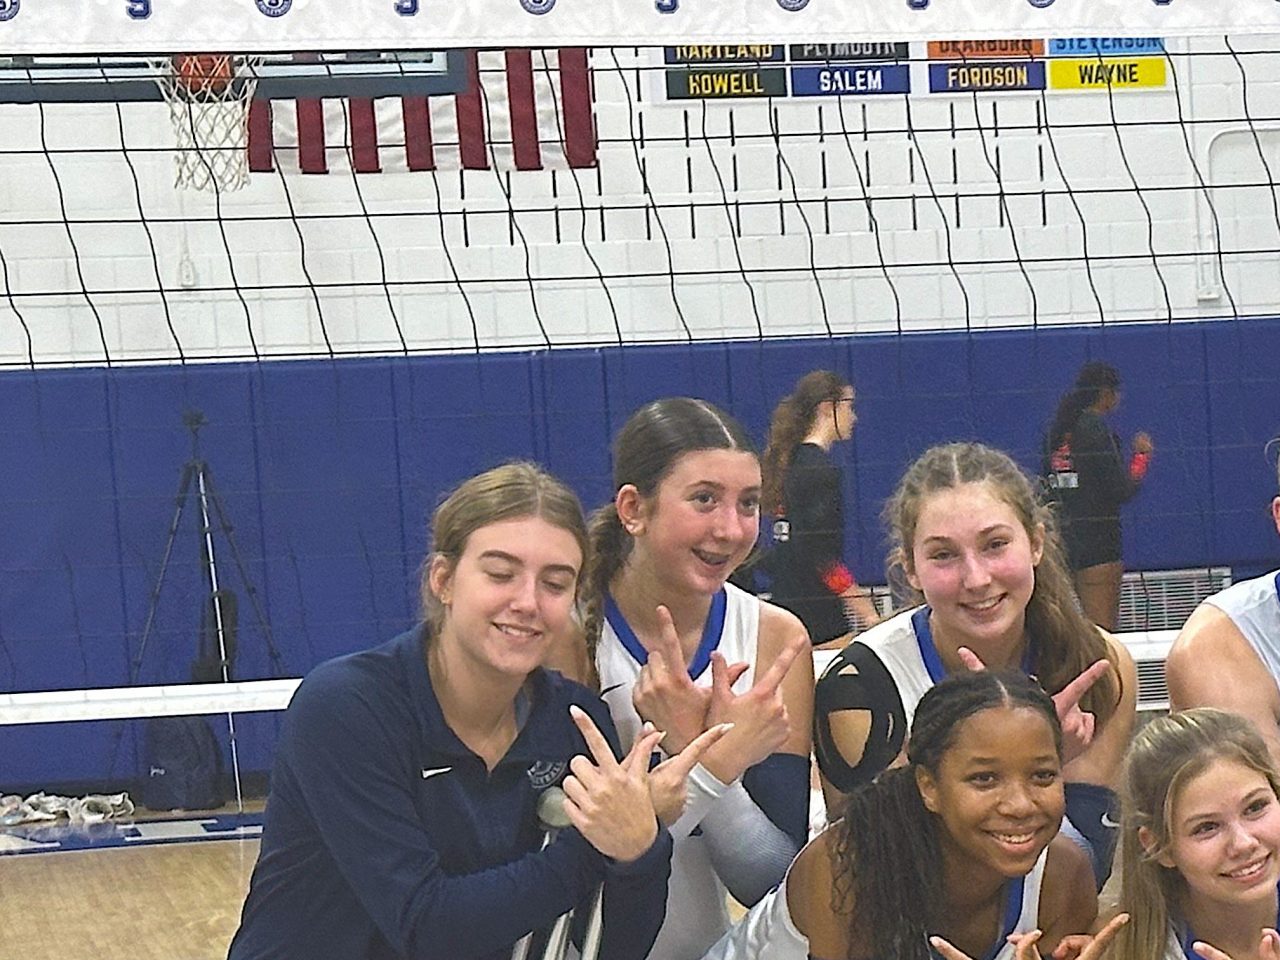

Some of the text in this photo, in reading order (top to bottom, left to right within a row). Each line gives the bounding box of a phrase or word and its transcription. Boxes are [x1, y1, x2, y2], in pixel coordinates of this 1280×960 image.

[688, 73, 765, 95] HOWELL
[819, 69, 883, 92] SALEM
[947, 66, 1028, 88] FORDSON
[1079, 63, 1139, 85] WAYNE
